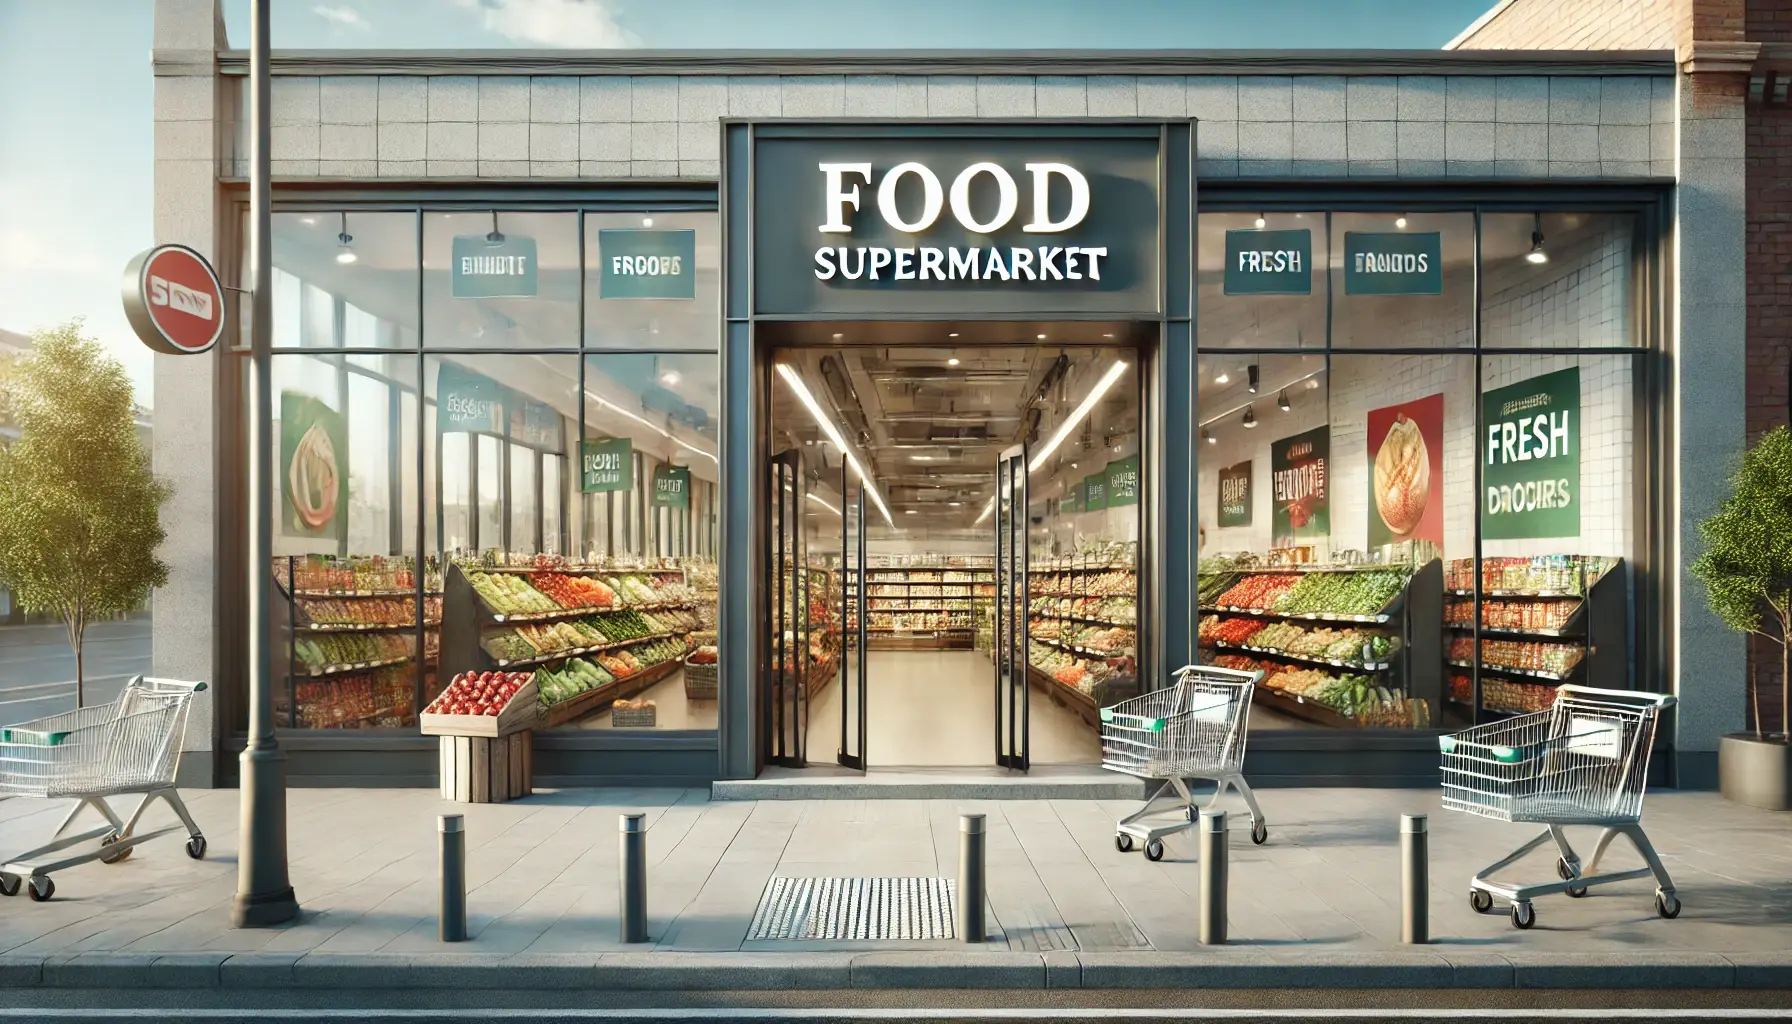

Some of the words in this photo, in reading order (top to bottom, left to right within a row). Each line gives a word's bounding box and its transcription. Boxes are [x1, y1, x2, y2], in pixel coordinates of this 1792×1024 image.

[818, 162, 1090, 233] FOOD
[814, 246, 1107, 281] SUPERMARKET
[1239, 251, 1301, 273] FRESH
[1488, 410, 1569, 464] FRESH
